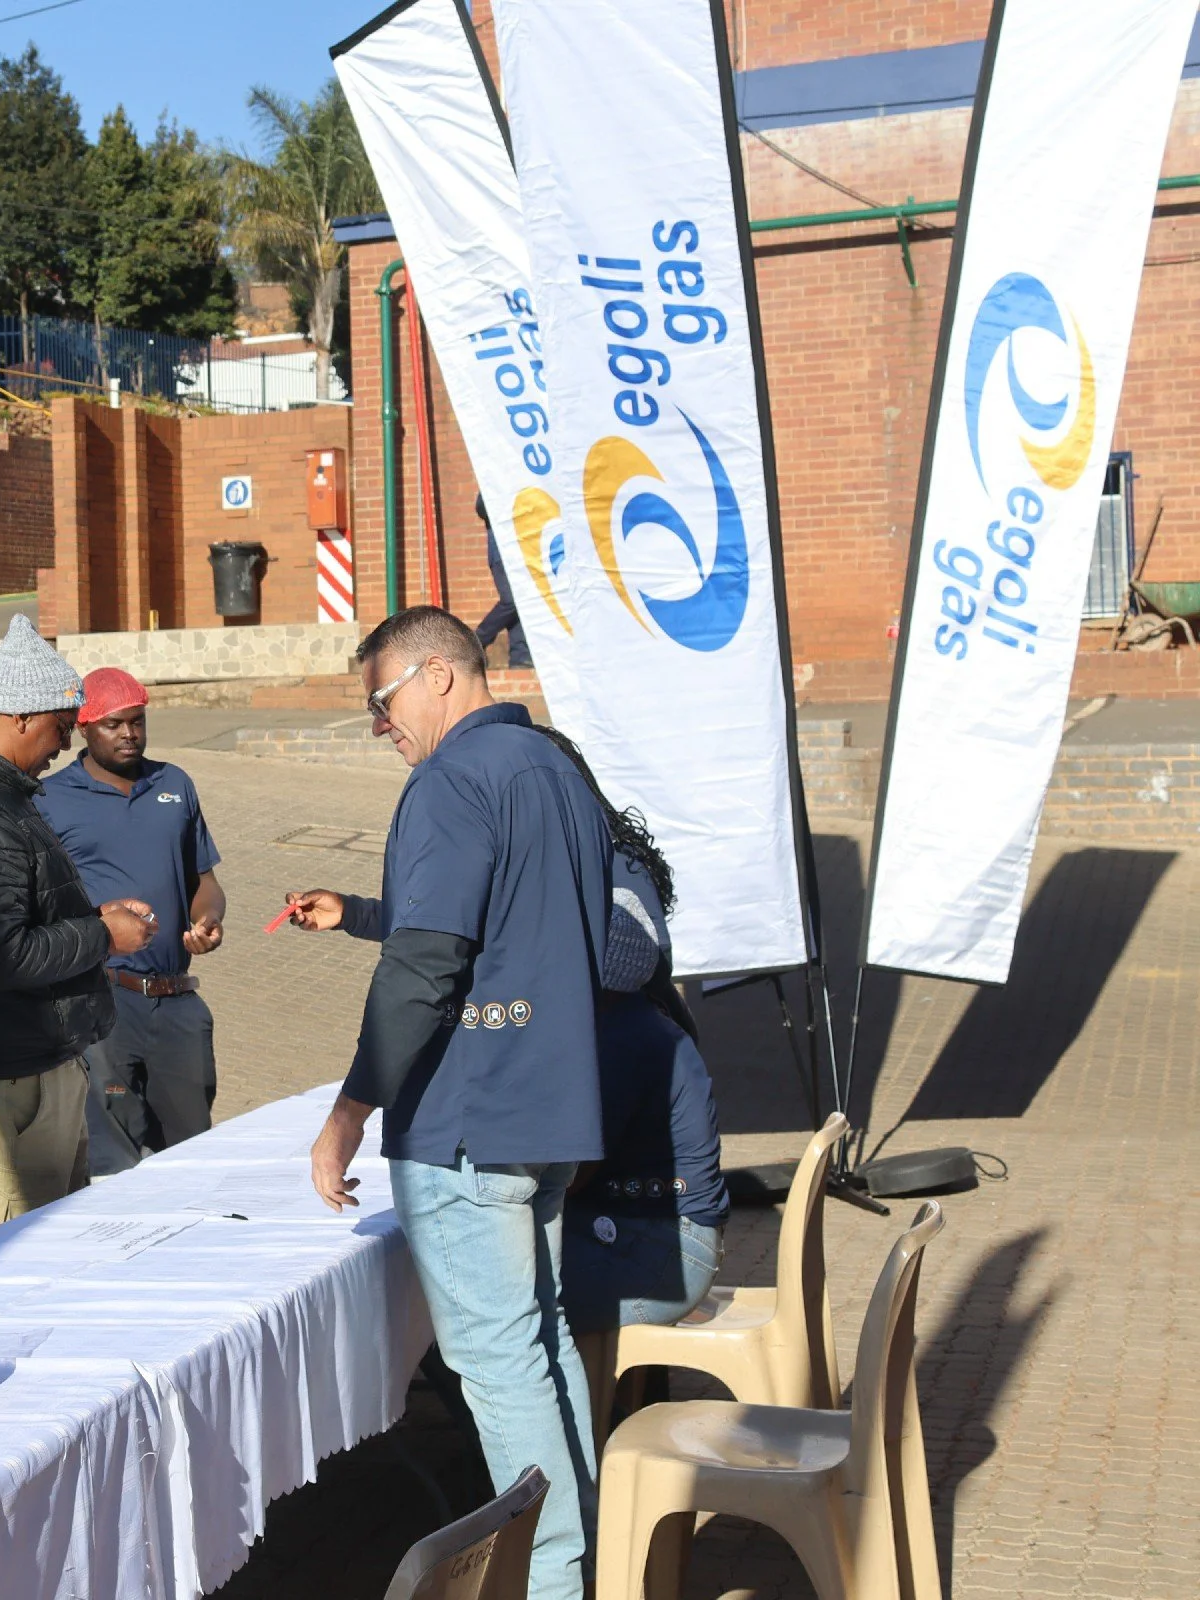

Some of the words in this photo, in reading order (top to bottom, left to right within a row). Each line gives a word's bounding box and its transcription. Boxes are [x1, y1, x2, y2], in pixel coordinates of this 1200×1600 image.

[577, 253, 672, 427] egoli
[652, 219, 728, 344] gas
[468, 324, 553, 476] egoli
[933, 539, 984, 661] gas
[982, 486, 1045, 655] egoli
